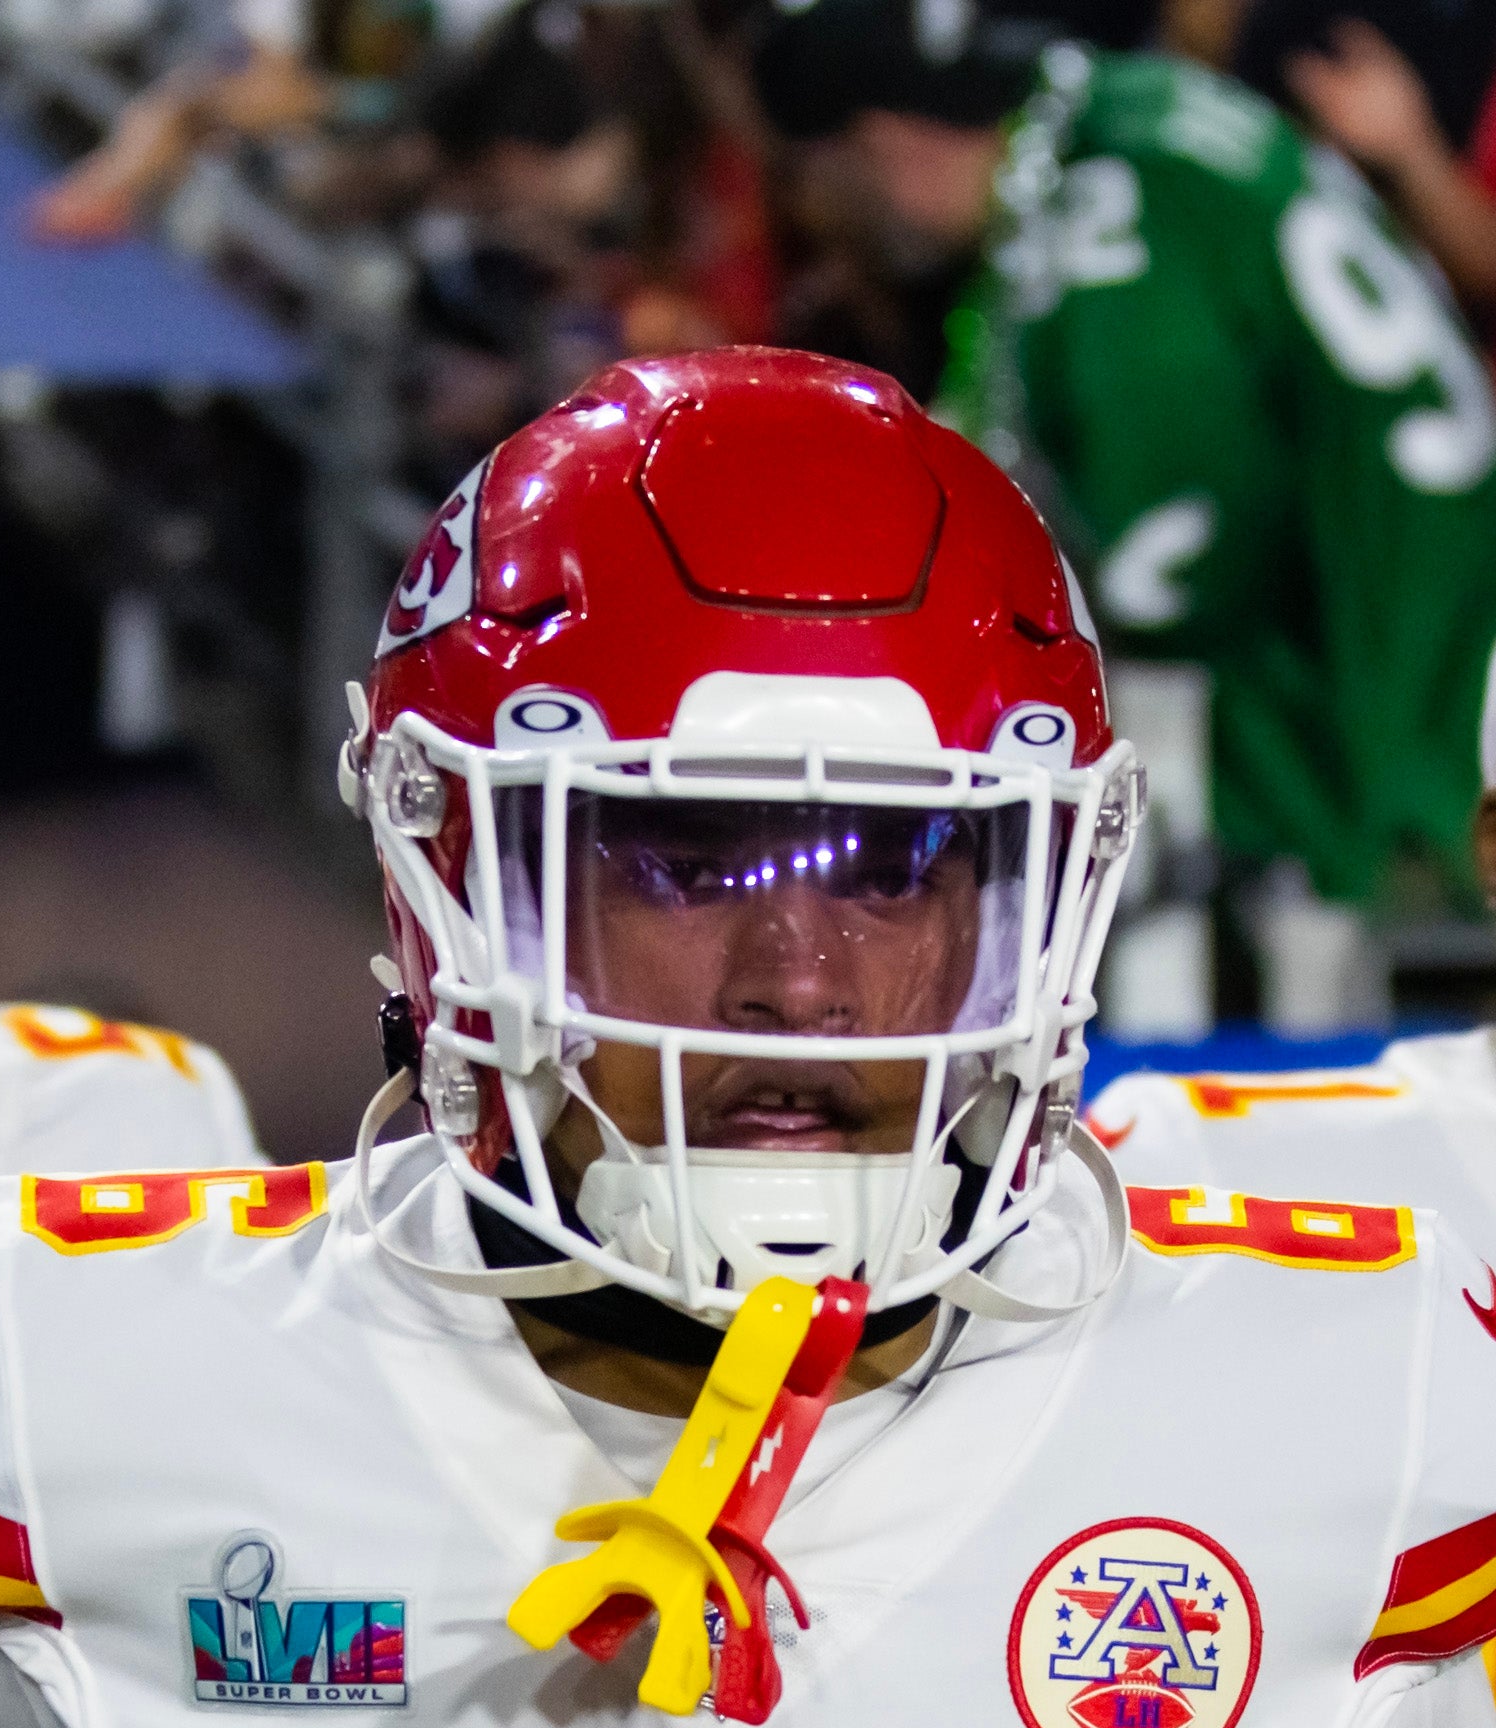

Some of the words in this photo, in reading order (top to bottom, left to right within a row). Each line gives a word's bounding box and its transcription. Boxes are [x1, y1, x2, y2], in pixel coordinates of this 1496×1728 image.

[188, 1598, 405, 1684] LVII
[216, 1684, 292, 1700] SUPER
[307, 1687, 385, 1701] BOWL
